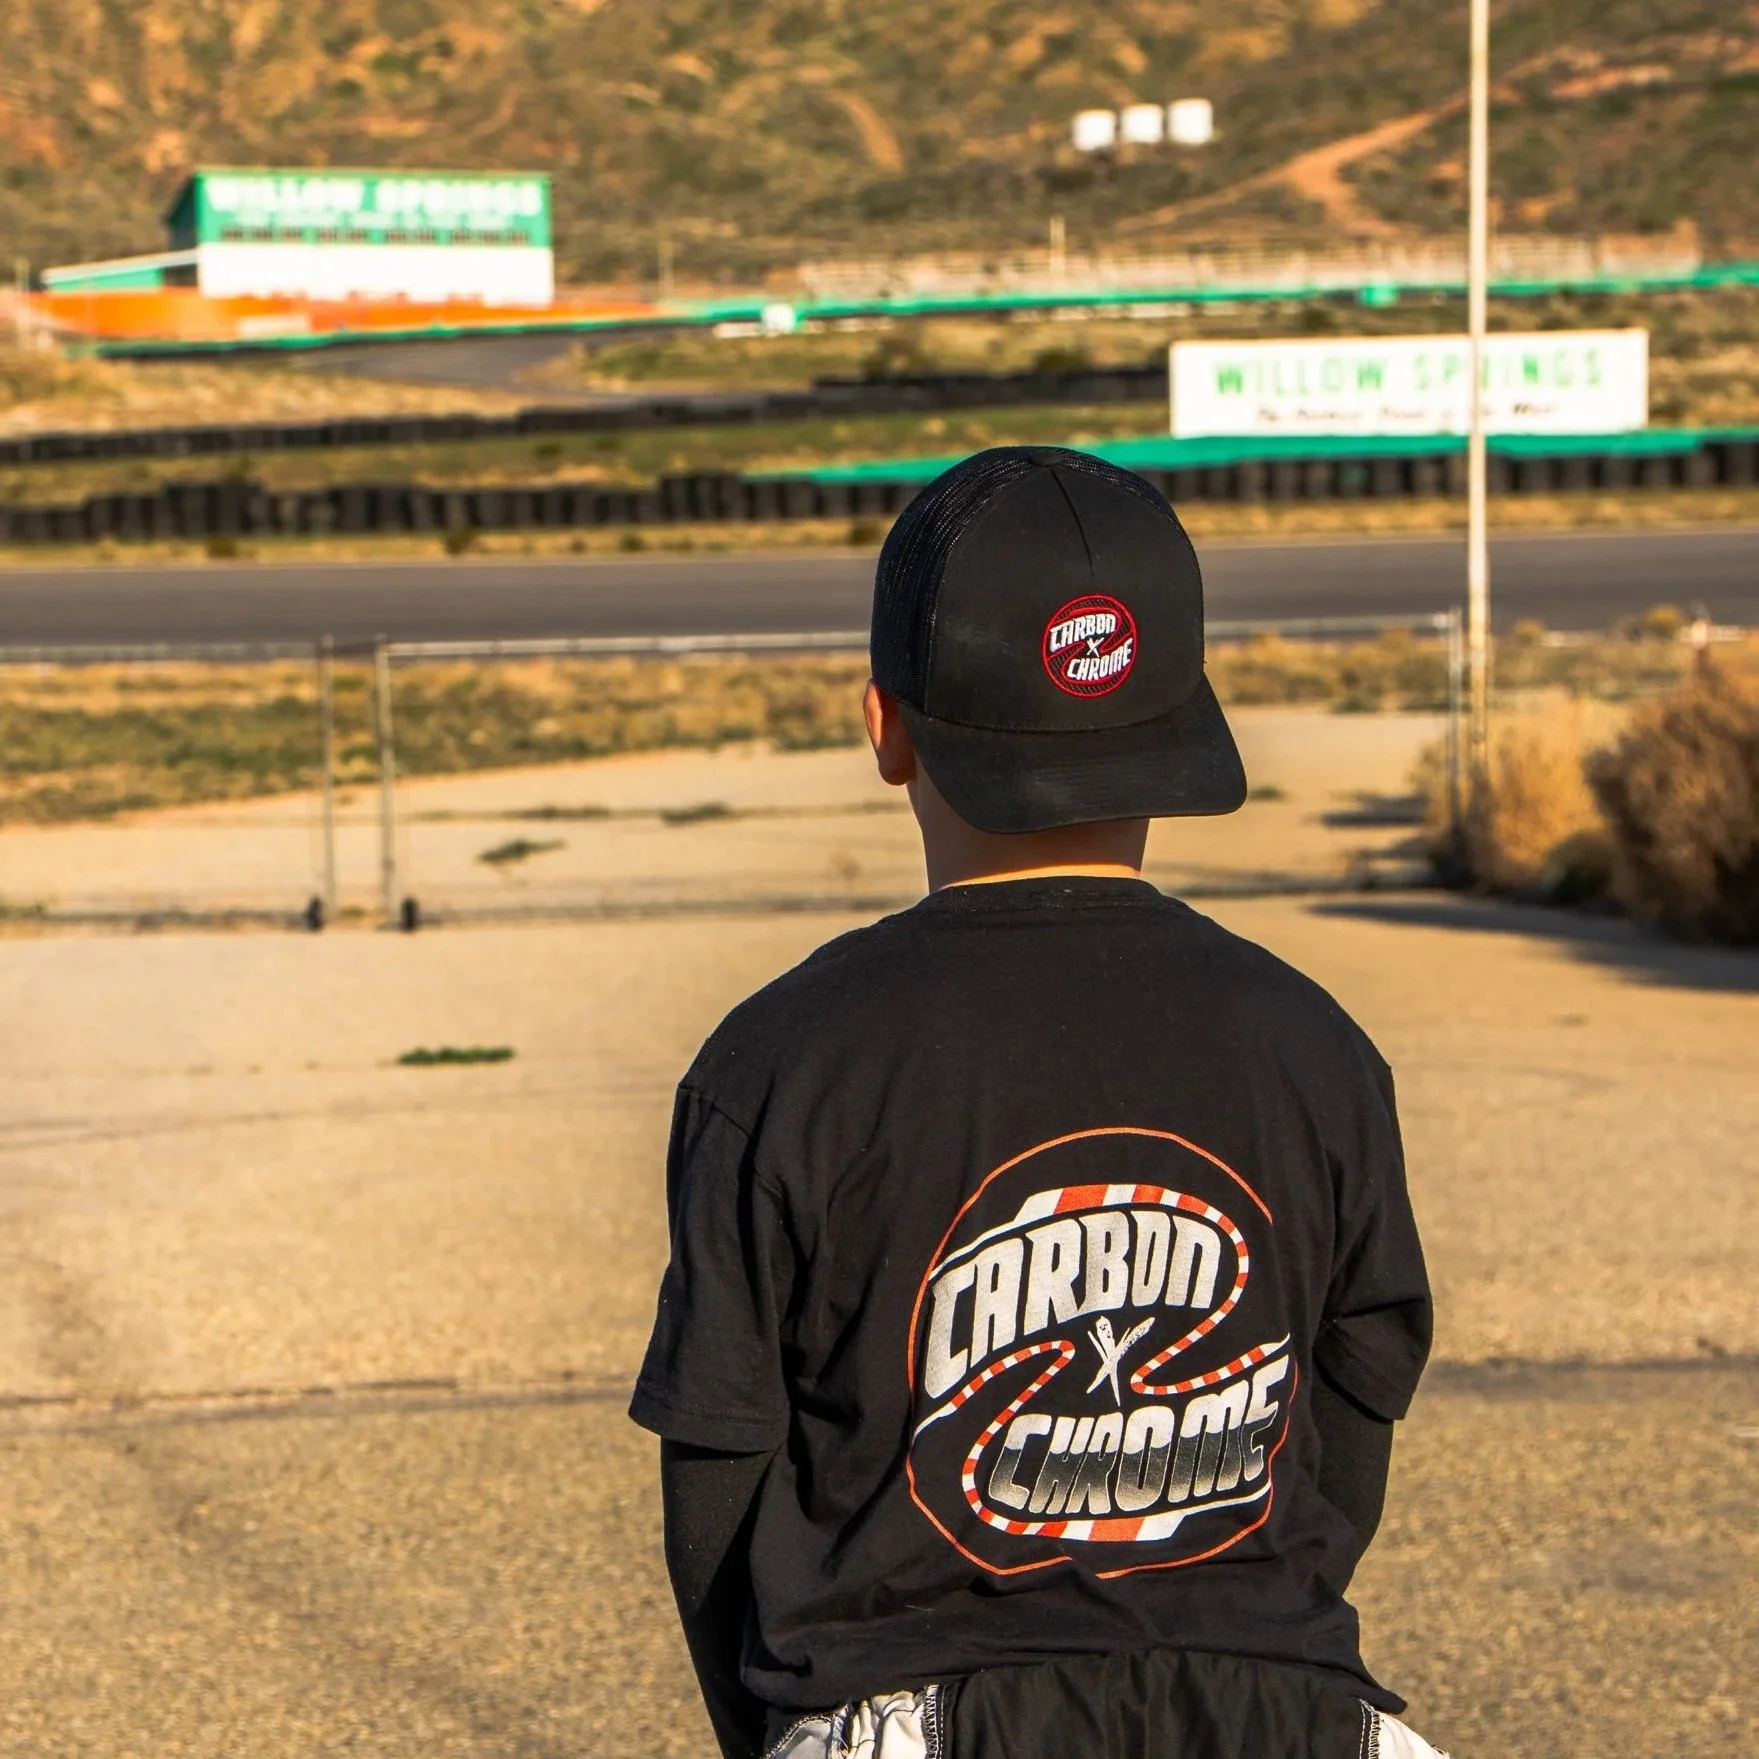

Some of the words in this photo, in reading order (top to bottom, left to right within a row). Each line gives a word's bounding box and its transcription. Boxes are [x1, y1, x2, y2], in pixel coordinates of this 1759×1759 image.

[1214, 356, 1389, 396] WILLOW
[1049, 613, 1117, 653] CARBON
[1086, 637, 1105, 658] X
[1066, 637, 1134, 682] CHROME
[923, 1209, 1222, 1400] CARBON
[987, 1354, 1290, 1515] CHROME
